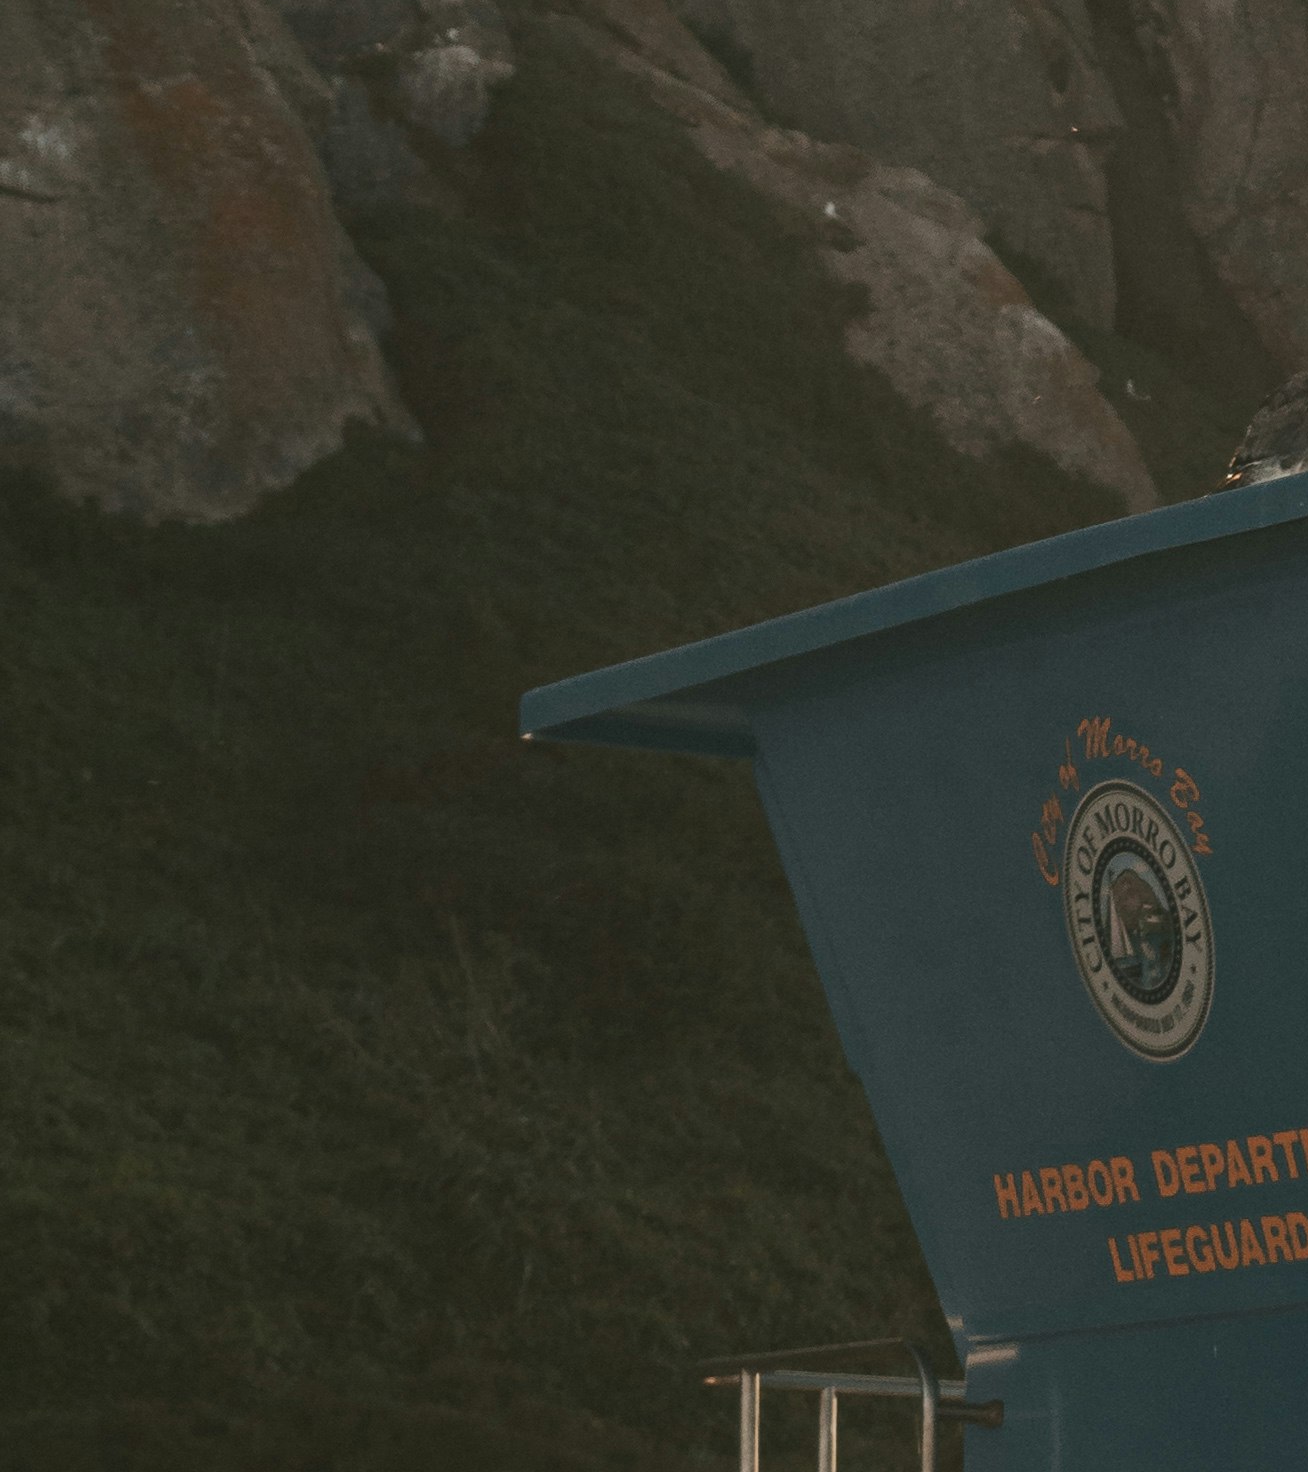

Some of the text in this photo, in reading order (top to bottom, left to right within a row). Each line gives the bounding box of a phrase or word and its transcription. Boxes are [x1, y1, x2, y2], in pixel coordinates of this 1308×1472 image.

[1077, 715, 1163, 778] Morro
[1170, 767, 1213, 856] Bay
[1074, 802, 1203, 974] CITY OF MORRO BAY
[994, 1156, 1140, 1218] HARBOR
